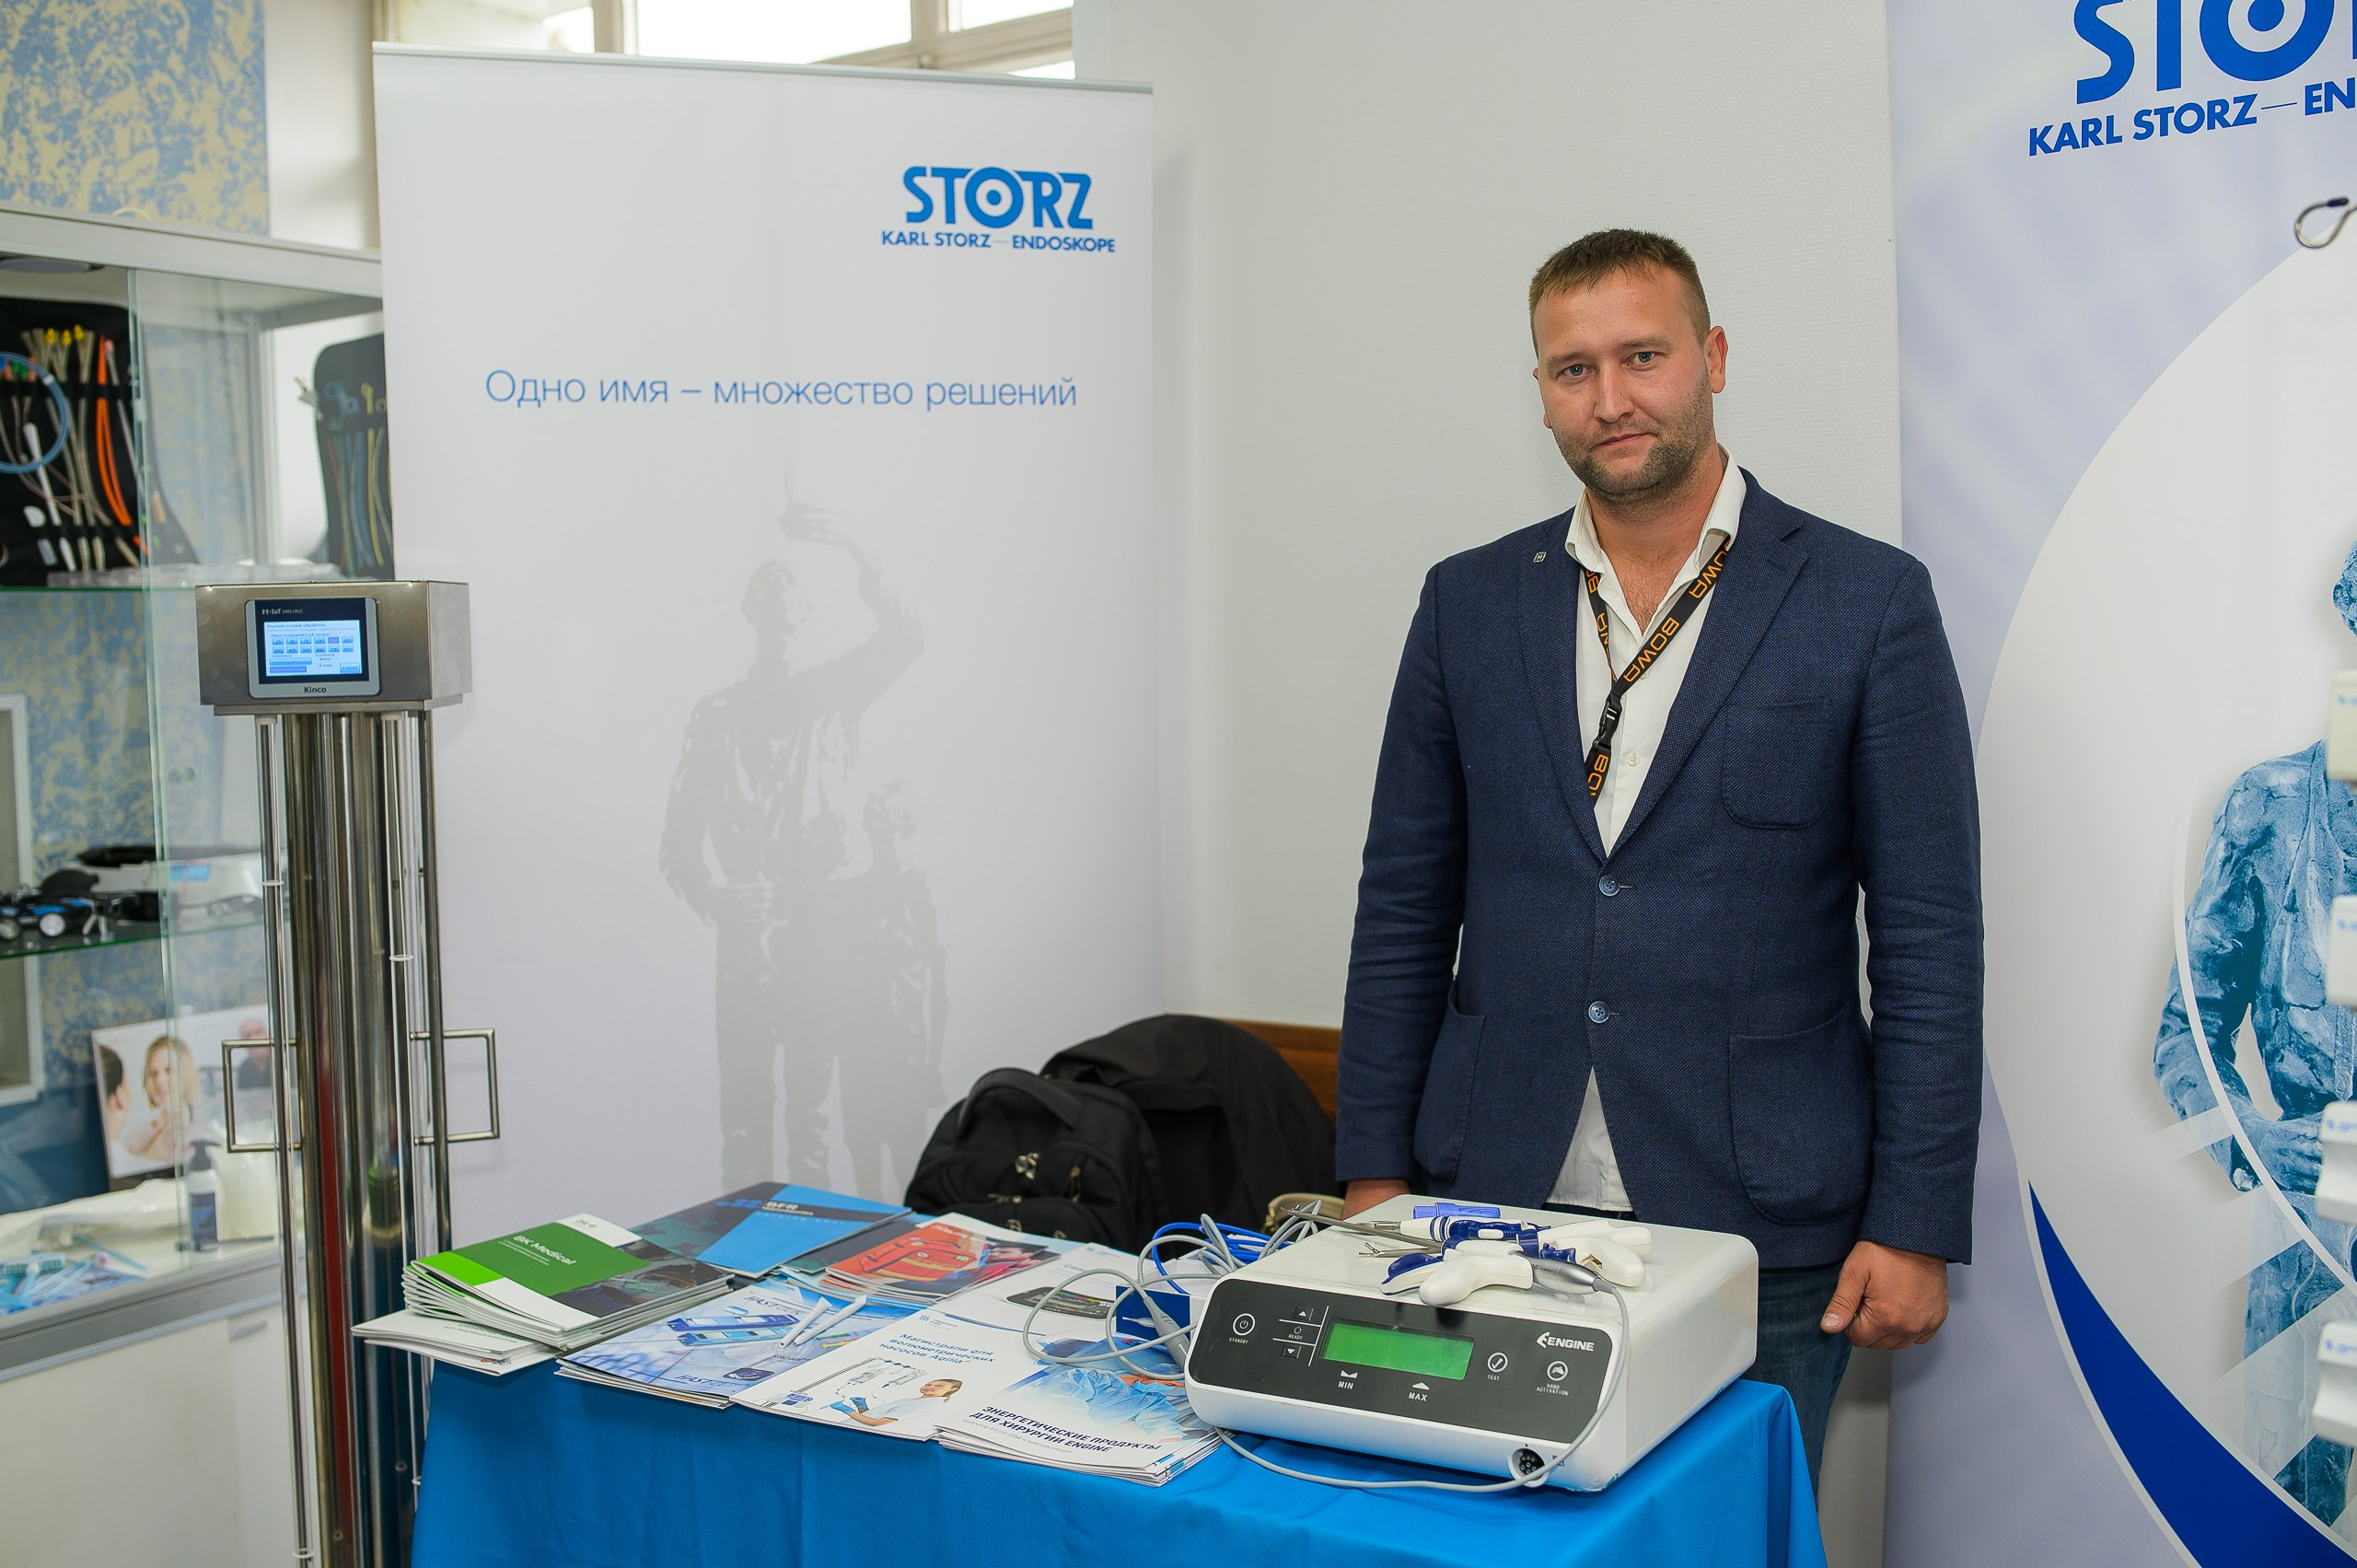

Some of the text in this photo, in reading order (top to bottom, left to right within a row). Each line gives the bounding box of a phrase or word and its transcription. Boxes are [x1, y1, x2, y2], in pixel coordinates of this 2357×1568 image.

[2028, 114, 2123, 157] KARL
[2132, 93, 2258, 141] STORZ
[902, 166, 1094, 230] STORZ
[881, 230, 1116, 253] KARL STORZ ENDOSKOPE
[485, 369, 586, 409] Одно
[598, 378, 669, 403] имя
[713, 379, 914, 406] множество
[925, 377, 1078, 412] решений
[1623, 617, 1680, 682] BOWA
[1587, 754, 1609, 796] BO
[530, 1243, 577, 1266] Medical
[878, 1343, 927, 1357] насосов
[888, 1339, 996, 1363] волюметрических
[900, 1333, 994, 1356] Магистрали для
[1547, 1336, 1596, 1352] ENGINE
[1338, 1380, 1354, 1390] MIN
[1408, 1391, 1428, 1402] MAX
[969, 1411, 1113, 1453] ДЛЯ ХИРУРГИИ ENGINE
[981, 1406, 1162, 1450] ЭНЕРГЕТИЧЕСКИЕ ПРОДУКТЫ
